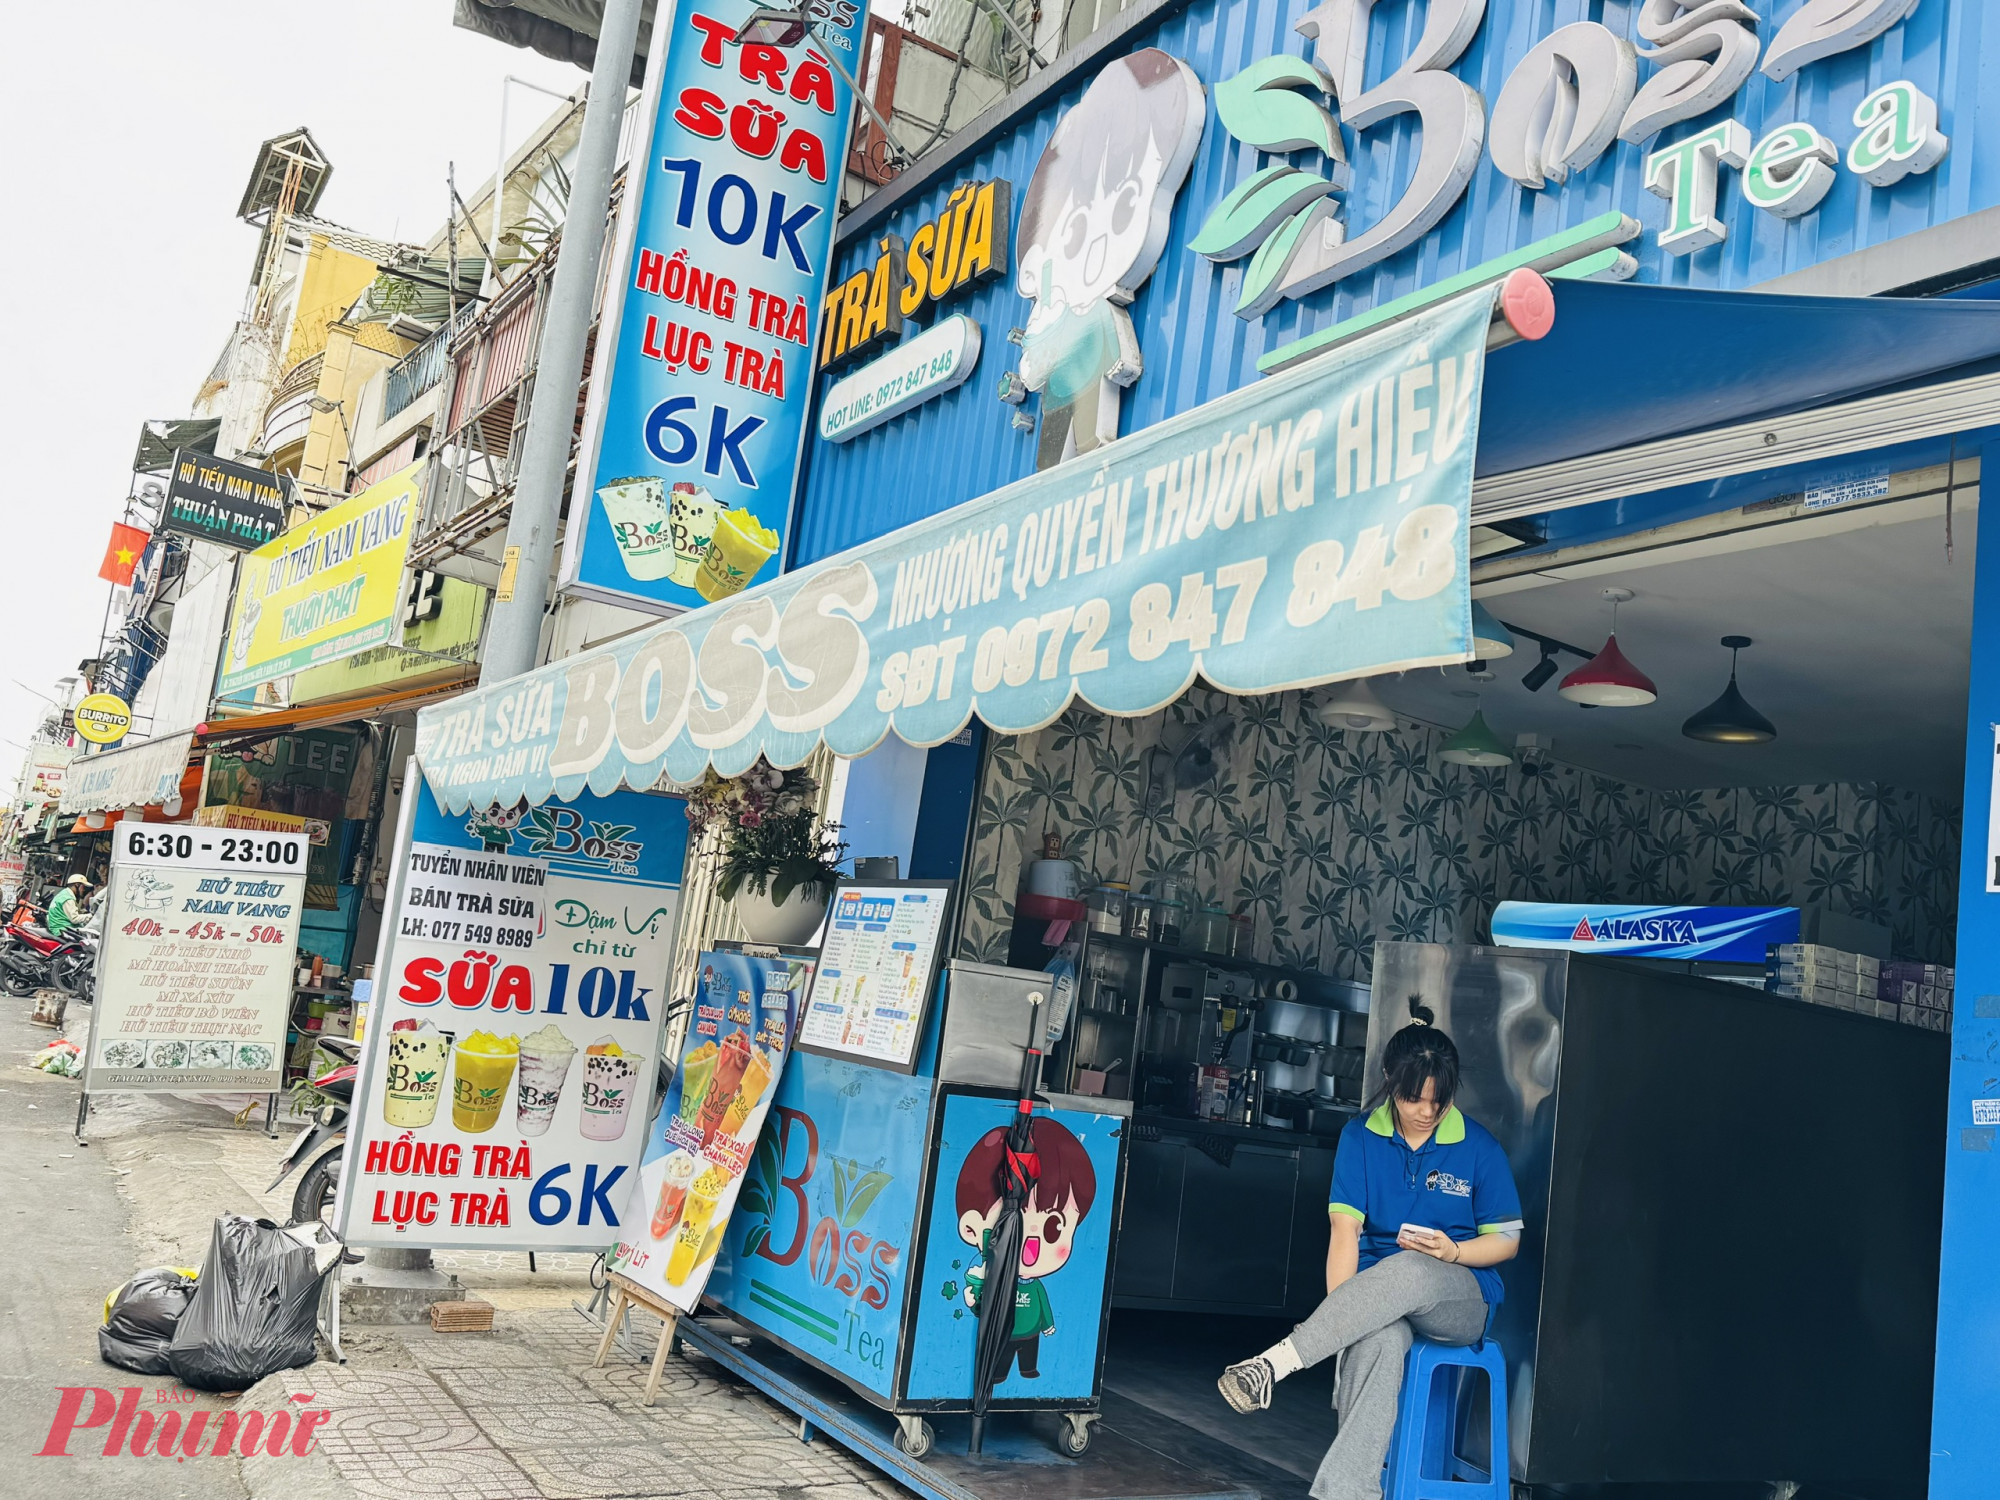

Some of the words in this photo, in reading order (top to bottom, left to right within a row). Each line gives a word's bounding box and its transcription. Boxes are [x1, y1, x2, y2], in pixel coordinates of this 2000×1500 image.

[691, 12, 837, 115] TRÀ
[674, 87, 828, 184] SỮA
[1647, 80, 1943, 252] Tea
[663, 157, 822, 277] 10K
[635, 248, 737, 319] HỒNG
[748, 288, 811, 348] TRÀ
[820, 238, 891, 368] TRÀ
[901, 181, 996, 317] SỮA
[641, 315, 713, 376] LỤC
[722, 340, 786, 401] TRÀ
[826, 406, 850, 433] HOT
[850, 396, 875, 422] LINE:
[876, 377, 903, 408] 0972
[904, 364, 928, 391] 847
[930, 350, 953, 378] 848
[643, 396, 768, 489] 6K
[179, 458, 196, 484] HỦ
[198, 466, 225, 493] TIẾU
[225, 476, 253, 501] NAM
[254, 483, 284, 510] VANG
[887, 524, 1008, 632] NHƯỢNG
[1012, 459, 1133, 601] QUYỀN
[1139, 408, 1323, 556] THƯƠNG
[1336, 343, 1477, 503] HIỆU
[172, 496, 231, 532] THUẬN
[231, 512, 276, 544] PHÁT
[265, 544, 288, 597] HỦ
[287, 527, 322, 586] TIẾU
[319, 518, 359, 571] NAM
[359, 492, 409, 554] VANG
[280, 590, 324, 642] THUẬN
[323, 563, 366, 623] PHÁT
[876, 635, 967, 713] SĐT
[972, 598, 1110, 693] 0972
[1128, 556, 1267, 662] 847
[1286, 504, 1459, 628] 848
[548, 560, 878, 777] BOSS
[80, 708, 128, 726] BURRITO
[432, 694, 486, 760] TRÀ
[491, 678, 554, 748] SỮA
[448, 757, 492, 786] NGON
[530, 744, 548, 778] VỊ
[129, 832, 192, 858] 6:30
[221, 839, 299, 864] 23:00
[260, 819, 279, 832] NAM
[545, 806, 643, 861] Boss
[235, 880, 284, 898] TIẾU
[411, 849, 461, 876] TUYỂN
[463, 857, 509, 881] NHÂN
[511, 862, 546, 887] VIÊN
[609, 860, 639, 877] Tea
[182, 899, 234, 915] NAM
[236, 902, 291, 918] VANG
[409, 886, 451, 910] BÁN
[456, 891, 492, 915] TRÀ
[500, 896, 535, 919] SỮA
[554, 899, 617, 935] Đậm
[624, 905, 668, 940] Vị
[122, 918, 164, 936] 40k
[186, 922, 224, 940] 45k
[246, 926, 285, 944] 50k
[401, 917, 427, 938] LH:
[431, 920, 461, 940] 077
[464, 923, 493, 946] 549
[496, 928, 533, 949] 8989
[573, 938, 606, 956] chỉ
[612, 941, 637, 958] từ
[1595, 918, 1699, 944] ALASKA
[398, 949, 534, 1015] SỮA
[541, 963, 654, 1022] 10k
[762, 993, 789, 1010] SELLER
[766, 971, 790, 992] BEST
[393, 1063, 437, 1093] Boss
[459, 1077, 501, 1105] Boss
[585, 1082, 625, 1109] Boss
[364, 1131, 462, 1177] HỒNG
[472, 1140, 533, 1179] TRÀ
[371, 1189, 440, 1232] LỤC
[450, 1188, 511, 1227] TRÀ
[528, 1162, 629, 1227] 6K
[755, 1105, 900, 1310] Boss
[844, 1309, 885, 1370] Tea
